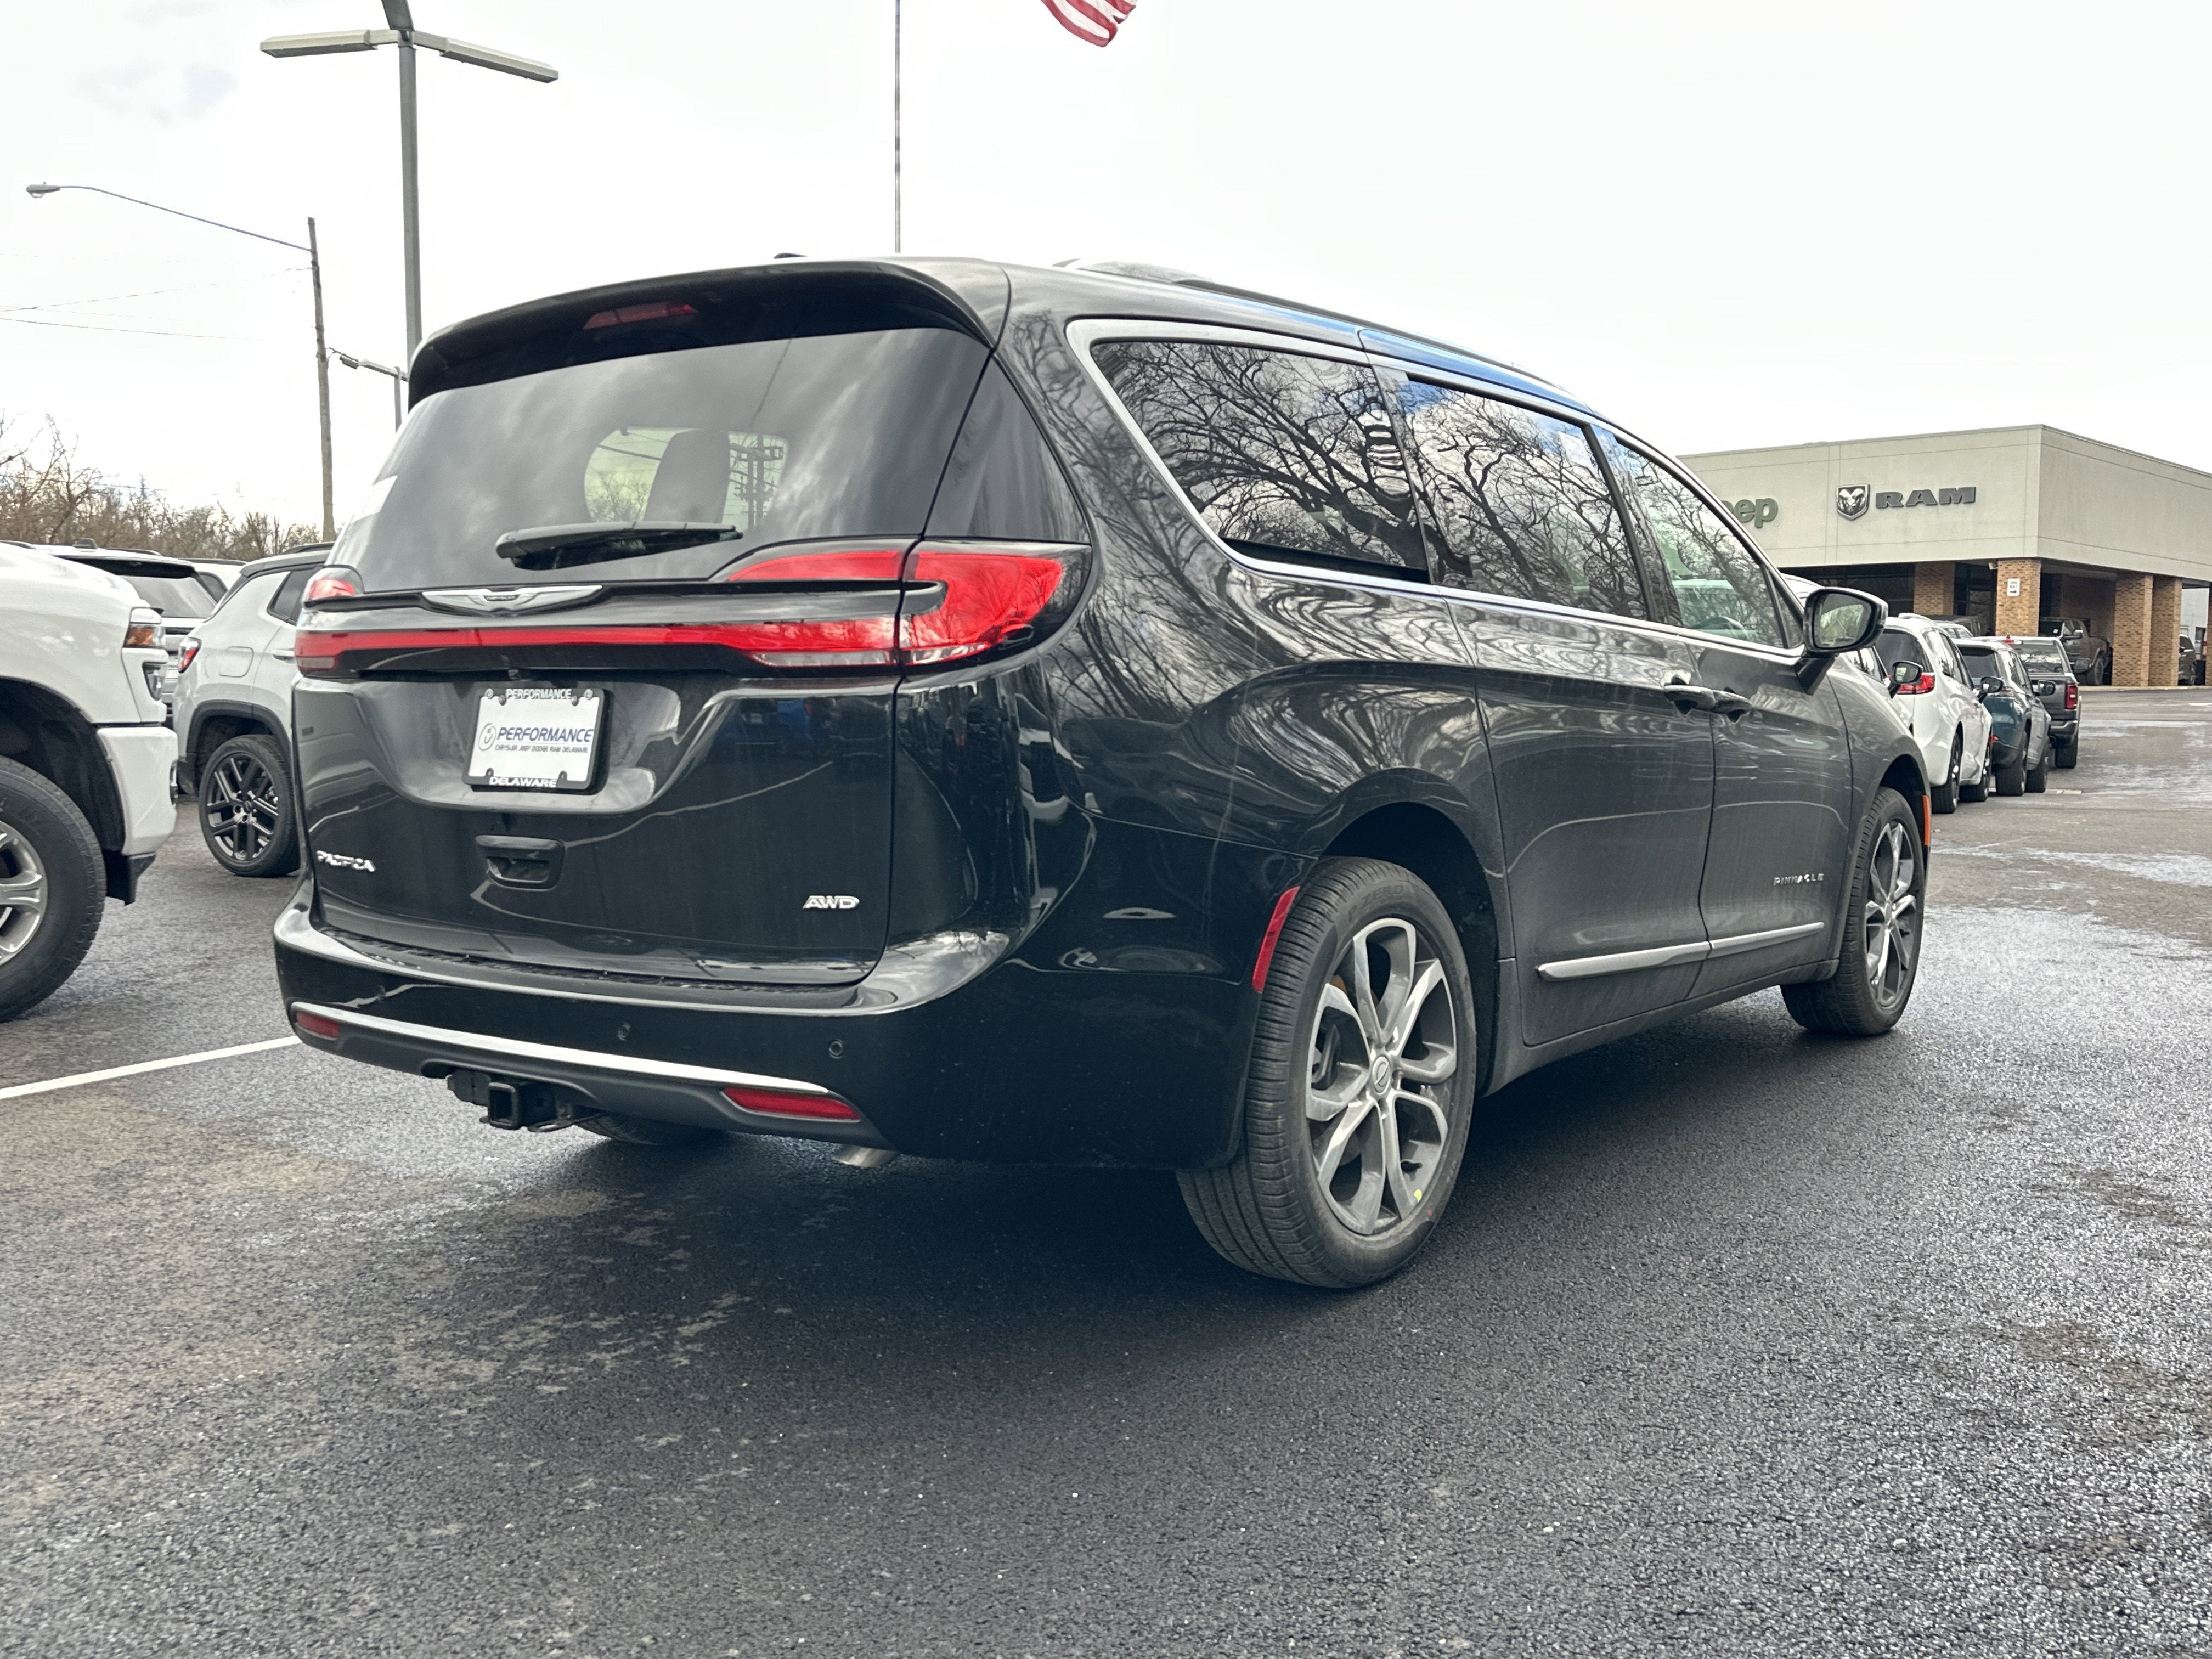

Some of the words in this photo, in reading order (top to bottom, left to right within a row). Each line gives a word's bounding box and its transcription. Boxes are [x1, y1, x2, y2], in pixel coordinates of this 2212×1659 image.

[1875, 486, 1976, 509] RAM
[505, 689, 572, 699] PERFORMANCE
[497, 727, 594, 742] PERFORMANCE
[489, 777, 557, 788] DELAWARE
[1773, 873, 1824, 886] PINNACLE
[803, 895, 860, 909] AWD
